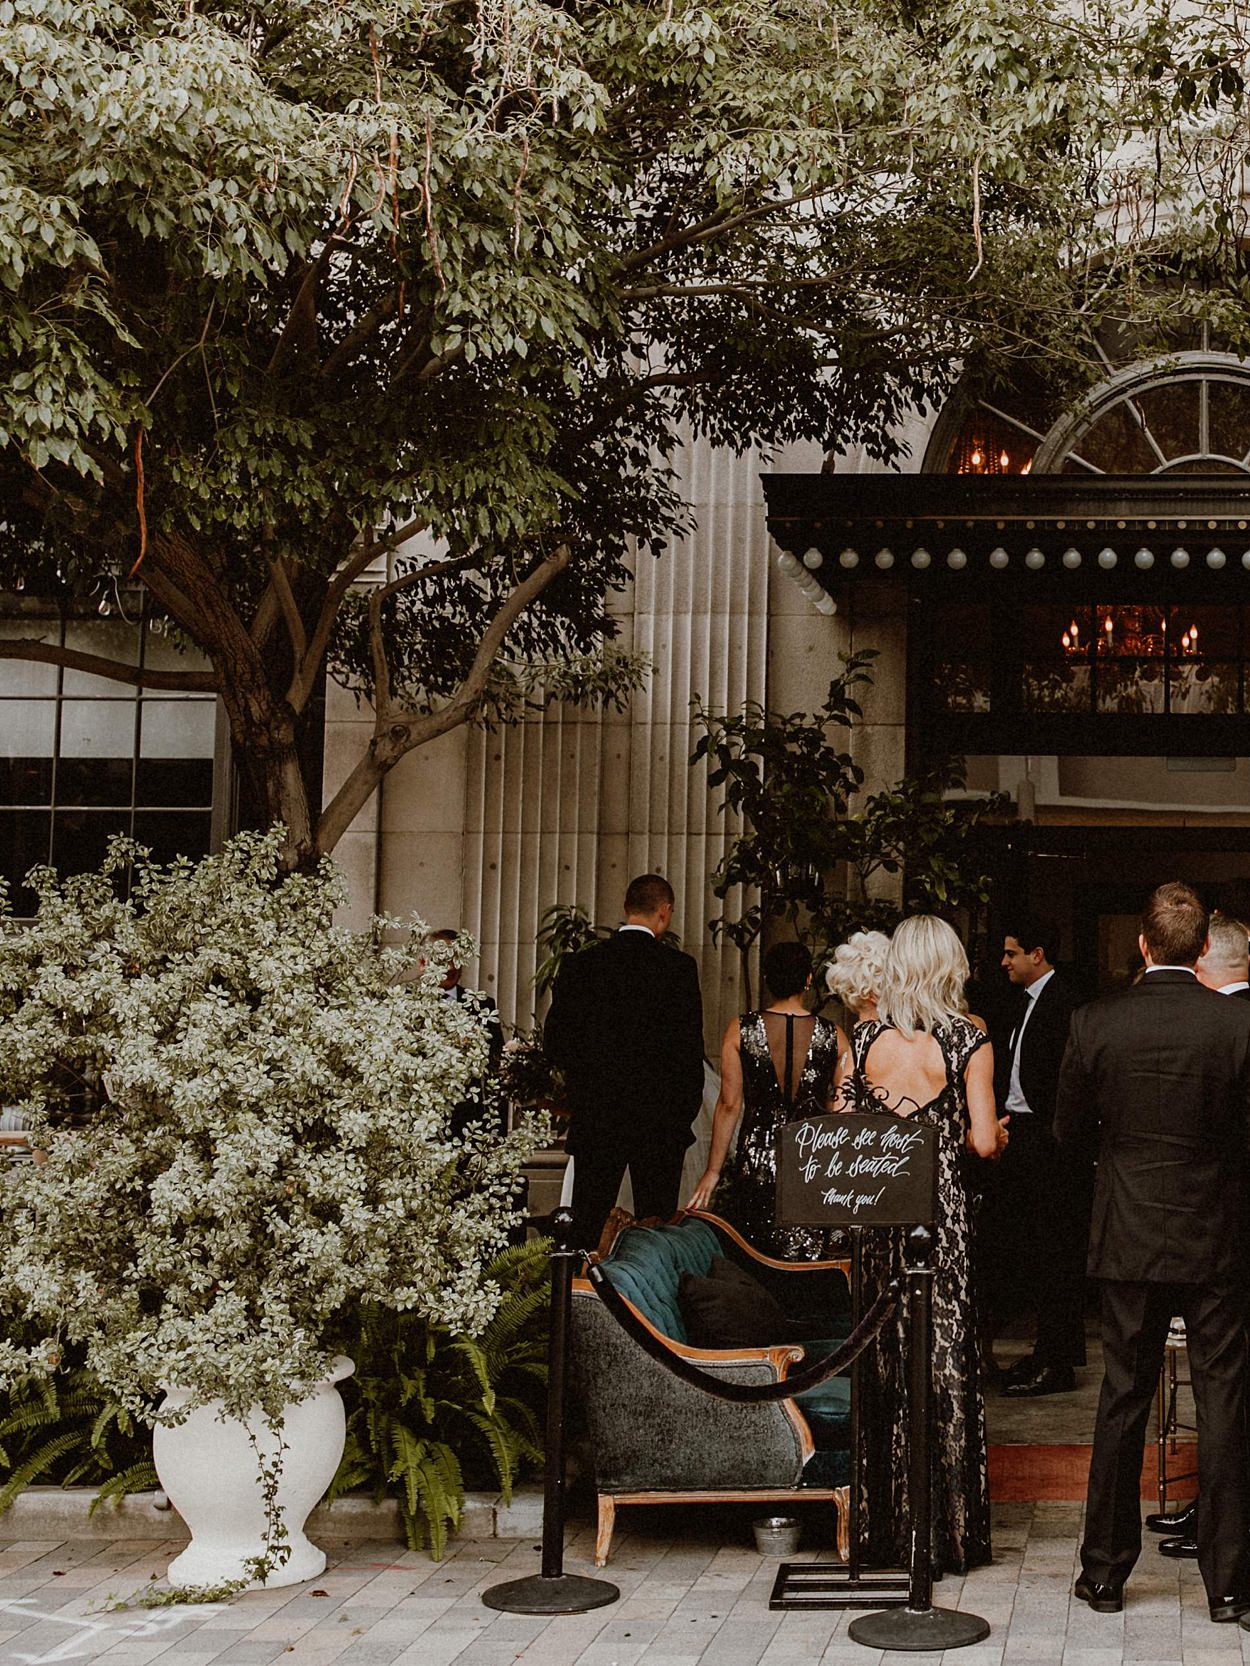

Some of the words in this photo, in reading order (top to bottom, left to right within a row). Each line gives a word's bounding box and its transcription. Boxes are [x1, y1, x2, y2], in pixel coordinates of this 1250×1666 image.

[795, 1122, 851, 1158] Please
[851, 1127, 877, 1150] see
[880, 1124, 925, 1154] host
[799, 1155, 821, 1183] to
[824, 1151, 843, 1178] be
[845, 1152, 911, 1178] seated
[852, 1186, 886, 1214] you!
